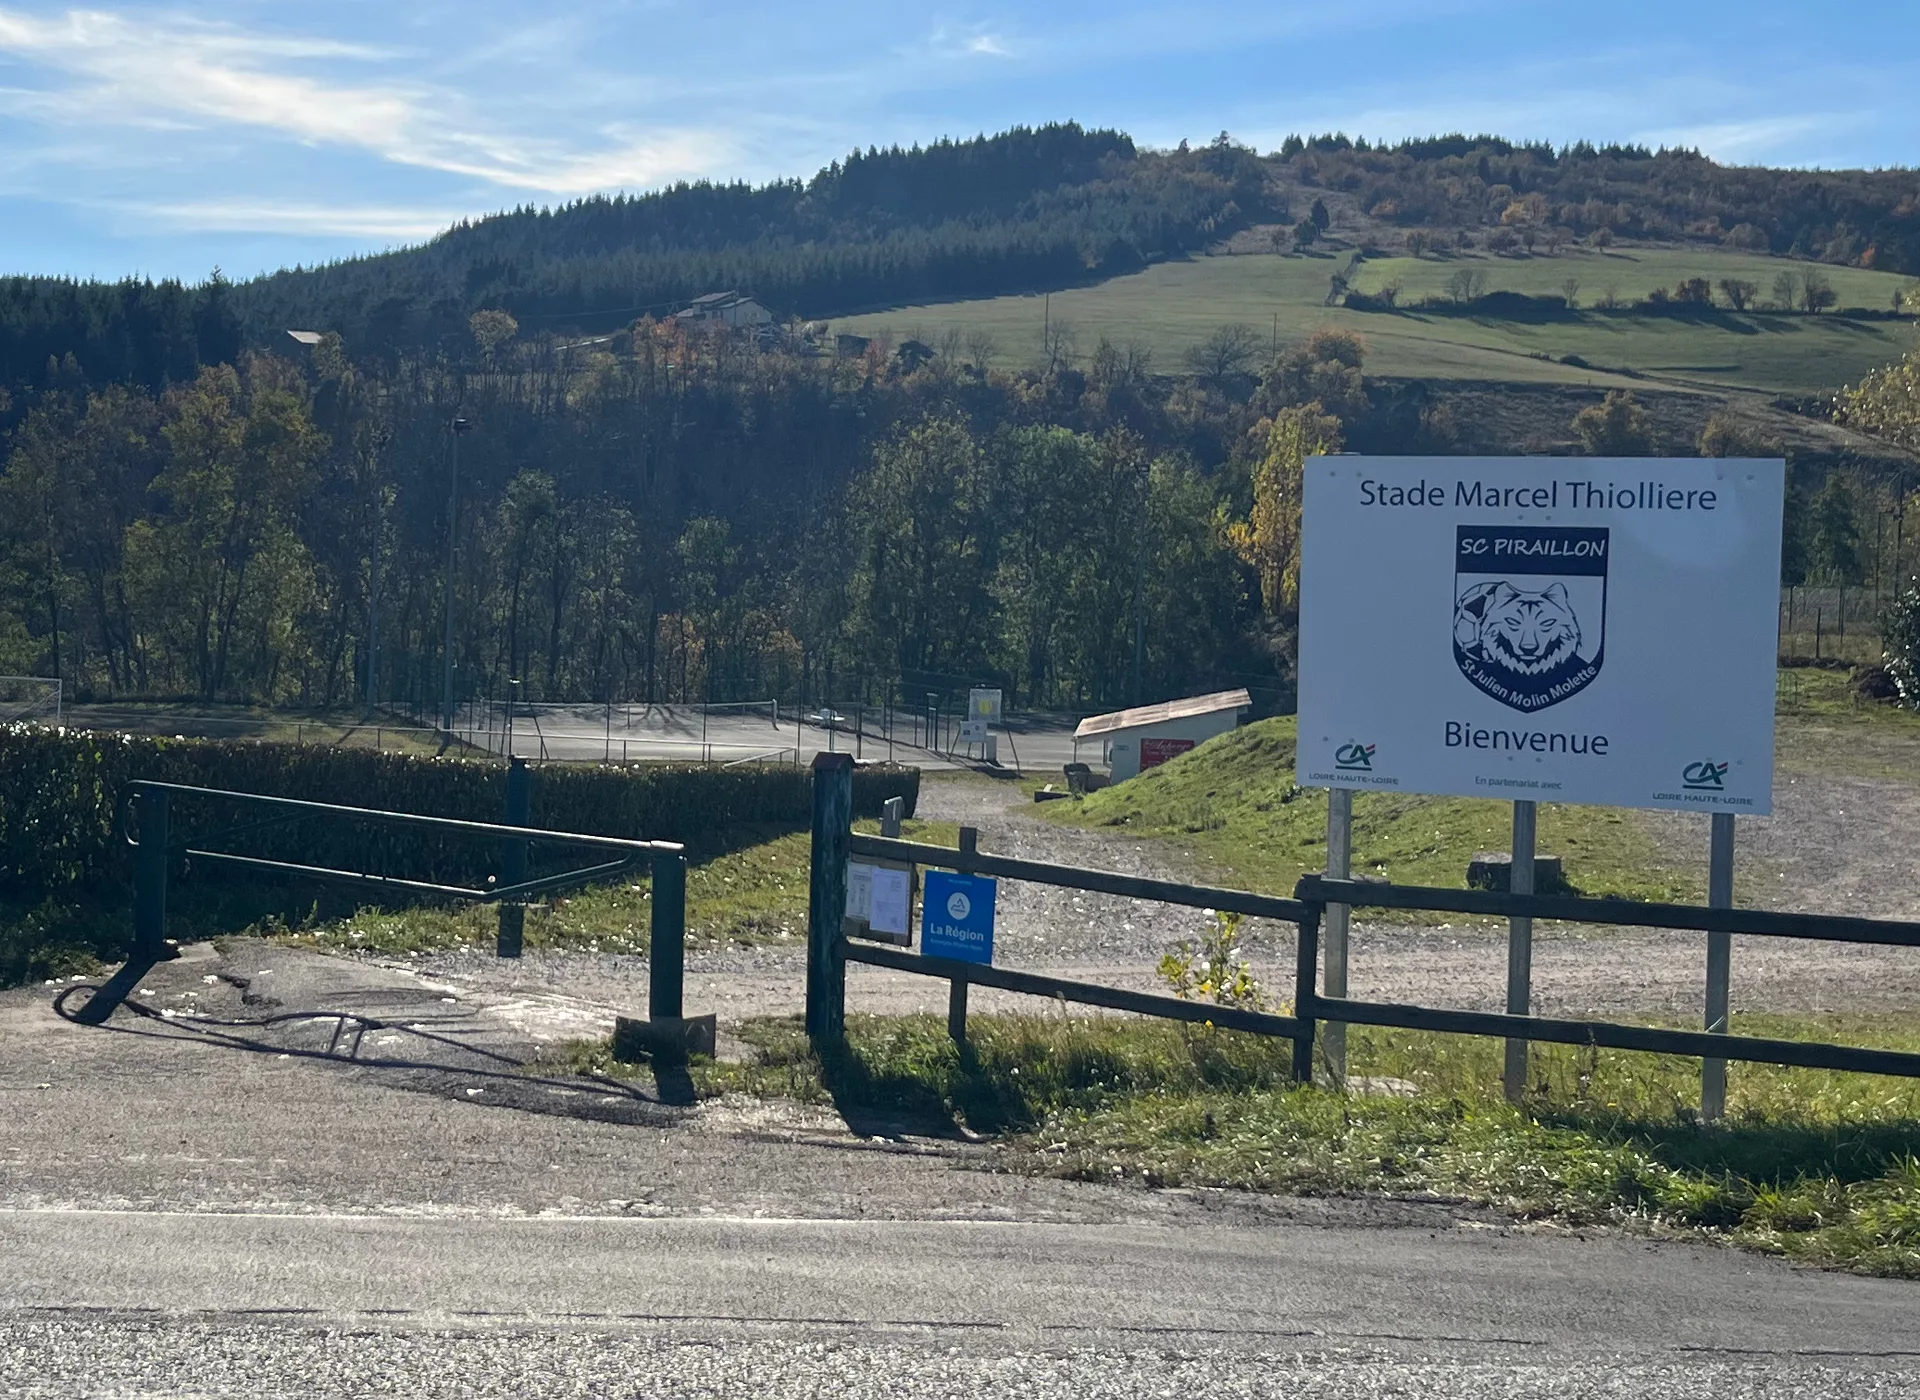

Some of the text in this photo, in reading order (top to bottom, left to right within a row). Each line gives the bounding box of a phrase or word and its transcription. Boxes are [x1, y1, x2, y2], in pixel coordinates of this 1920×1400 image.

[1359, 479, 1717, 510] Stade Marcel Thiolliere
[1460, 538, 1606, 557] SC PIRAILLON
[1461, 659, 1597, 707] St Julien Molin Molette
[1444, 721, 1609, 756] Bienvenue
[1308, 773, 1400, 785] LOIRE HAUTE-LOIRE
[1475, 776, 1562, 790] En partenariat avec
[1652, 792, 1754, 806] LOIRE HAUTE-LOIRE
[930, 922, 985, 941] La Région
